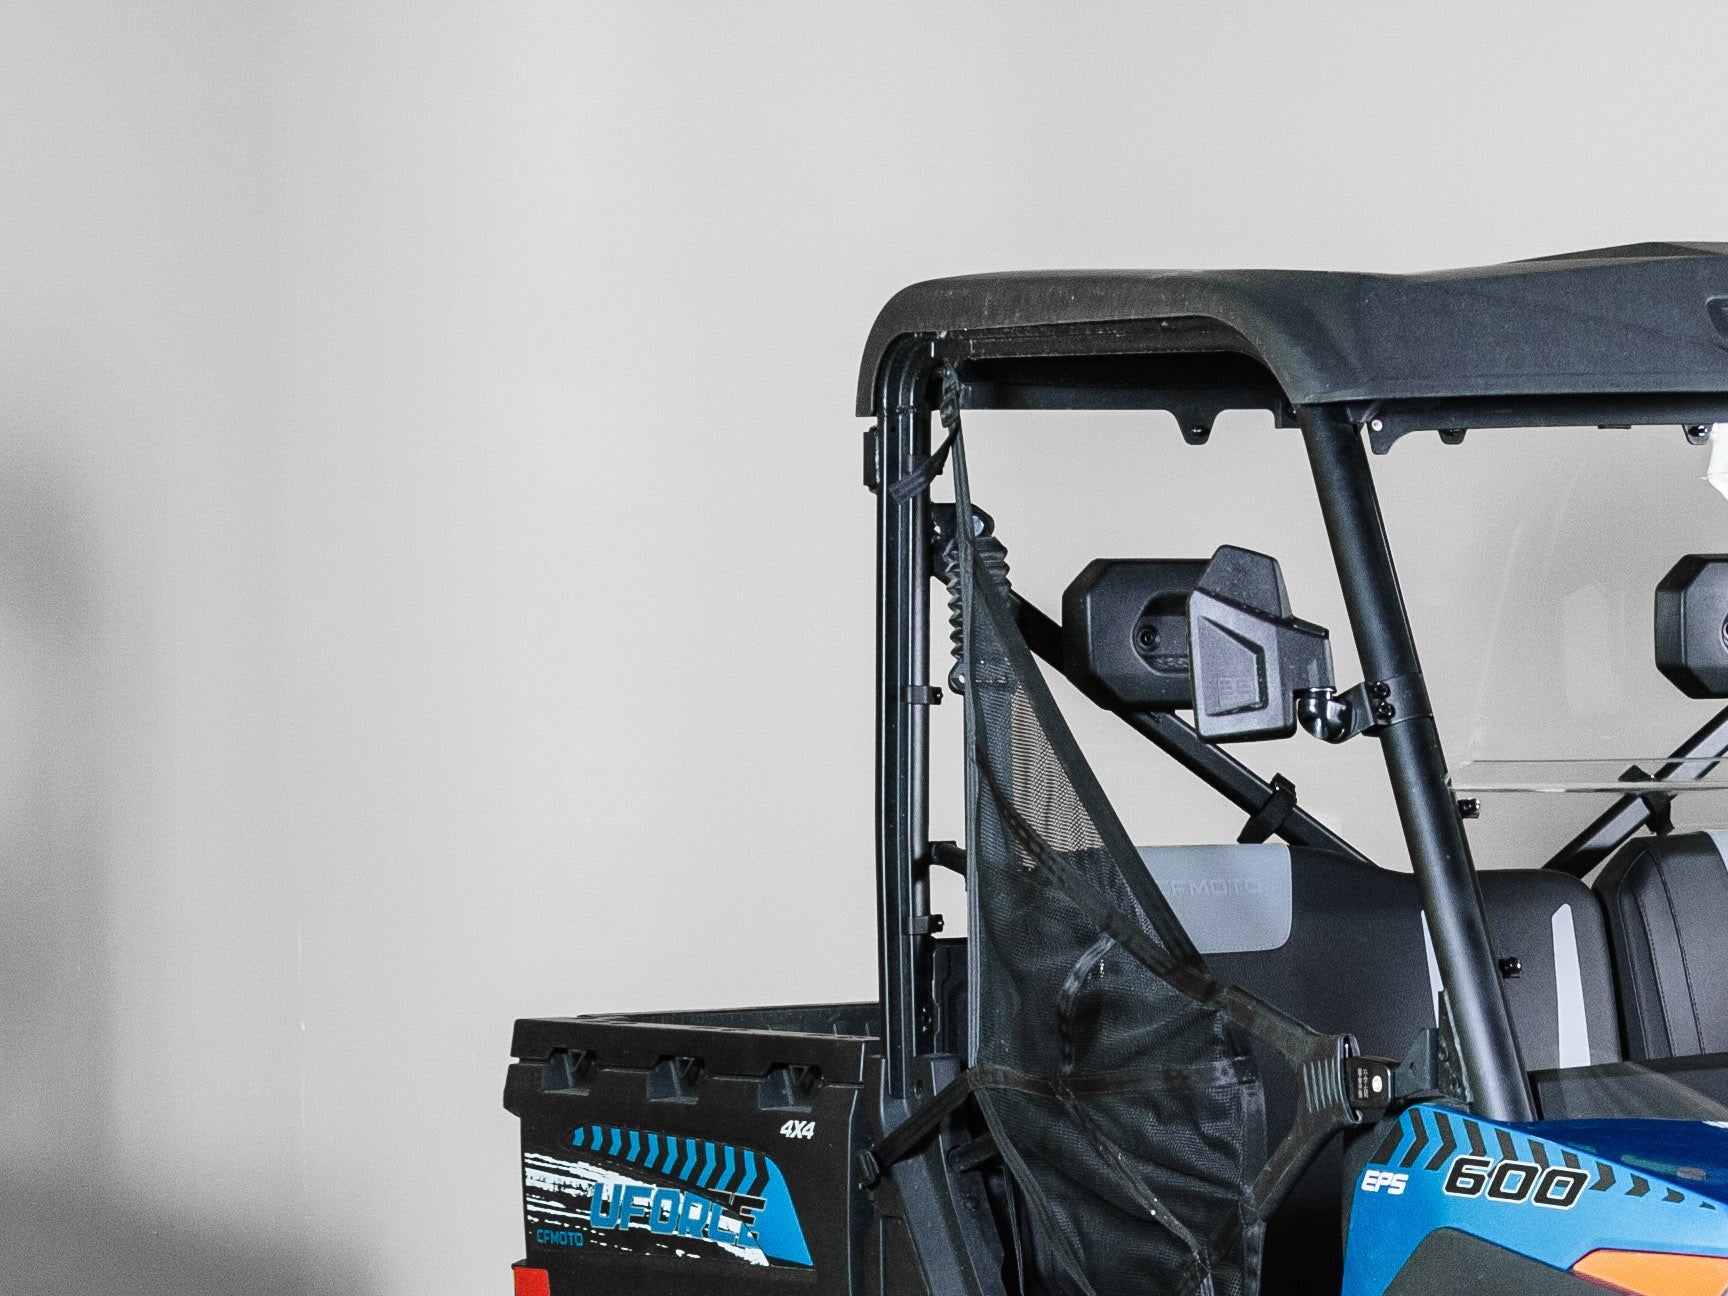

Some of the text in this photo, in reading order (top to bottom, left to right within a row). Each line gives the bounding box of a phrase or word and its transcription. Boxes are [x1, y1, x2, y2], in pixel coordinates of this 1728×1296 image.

[1361, 1168, 1409, 1195] EPS
[1443, 1154, 1591, 1210] 600
[590, 1182, 768, 1250] UFORCE
[536, 1227, 584, 1248] CFMOTO
